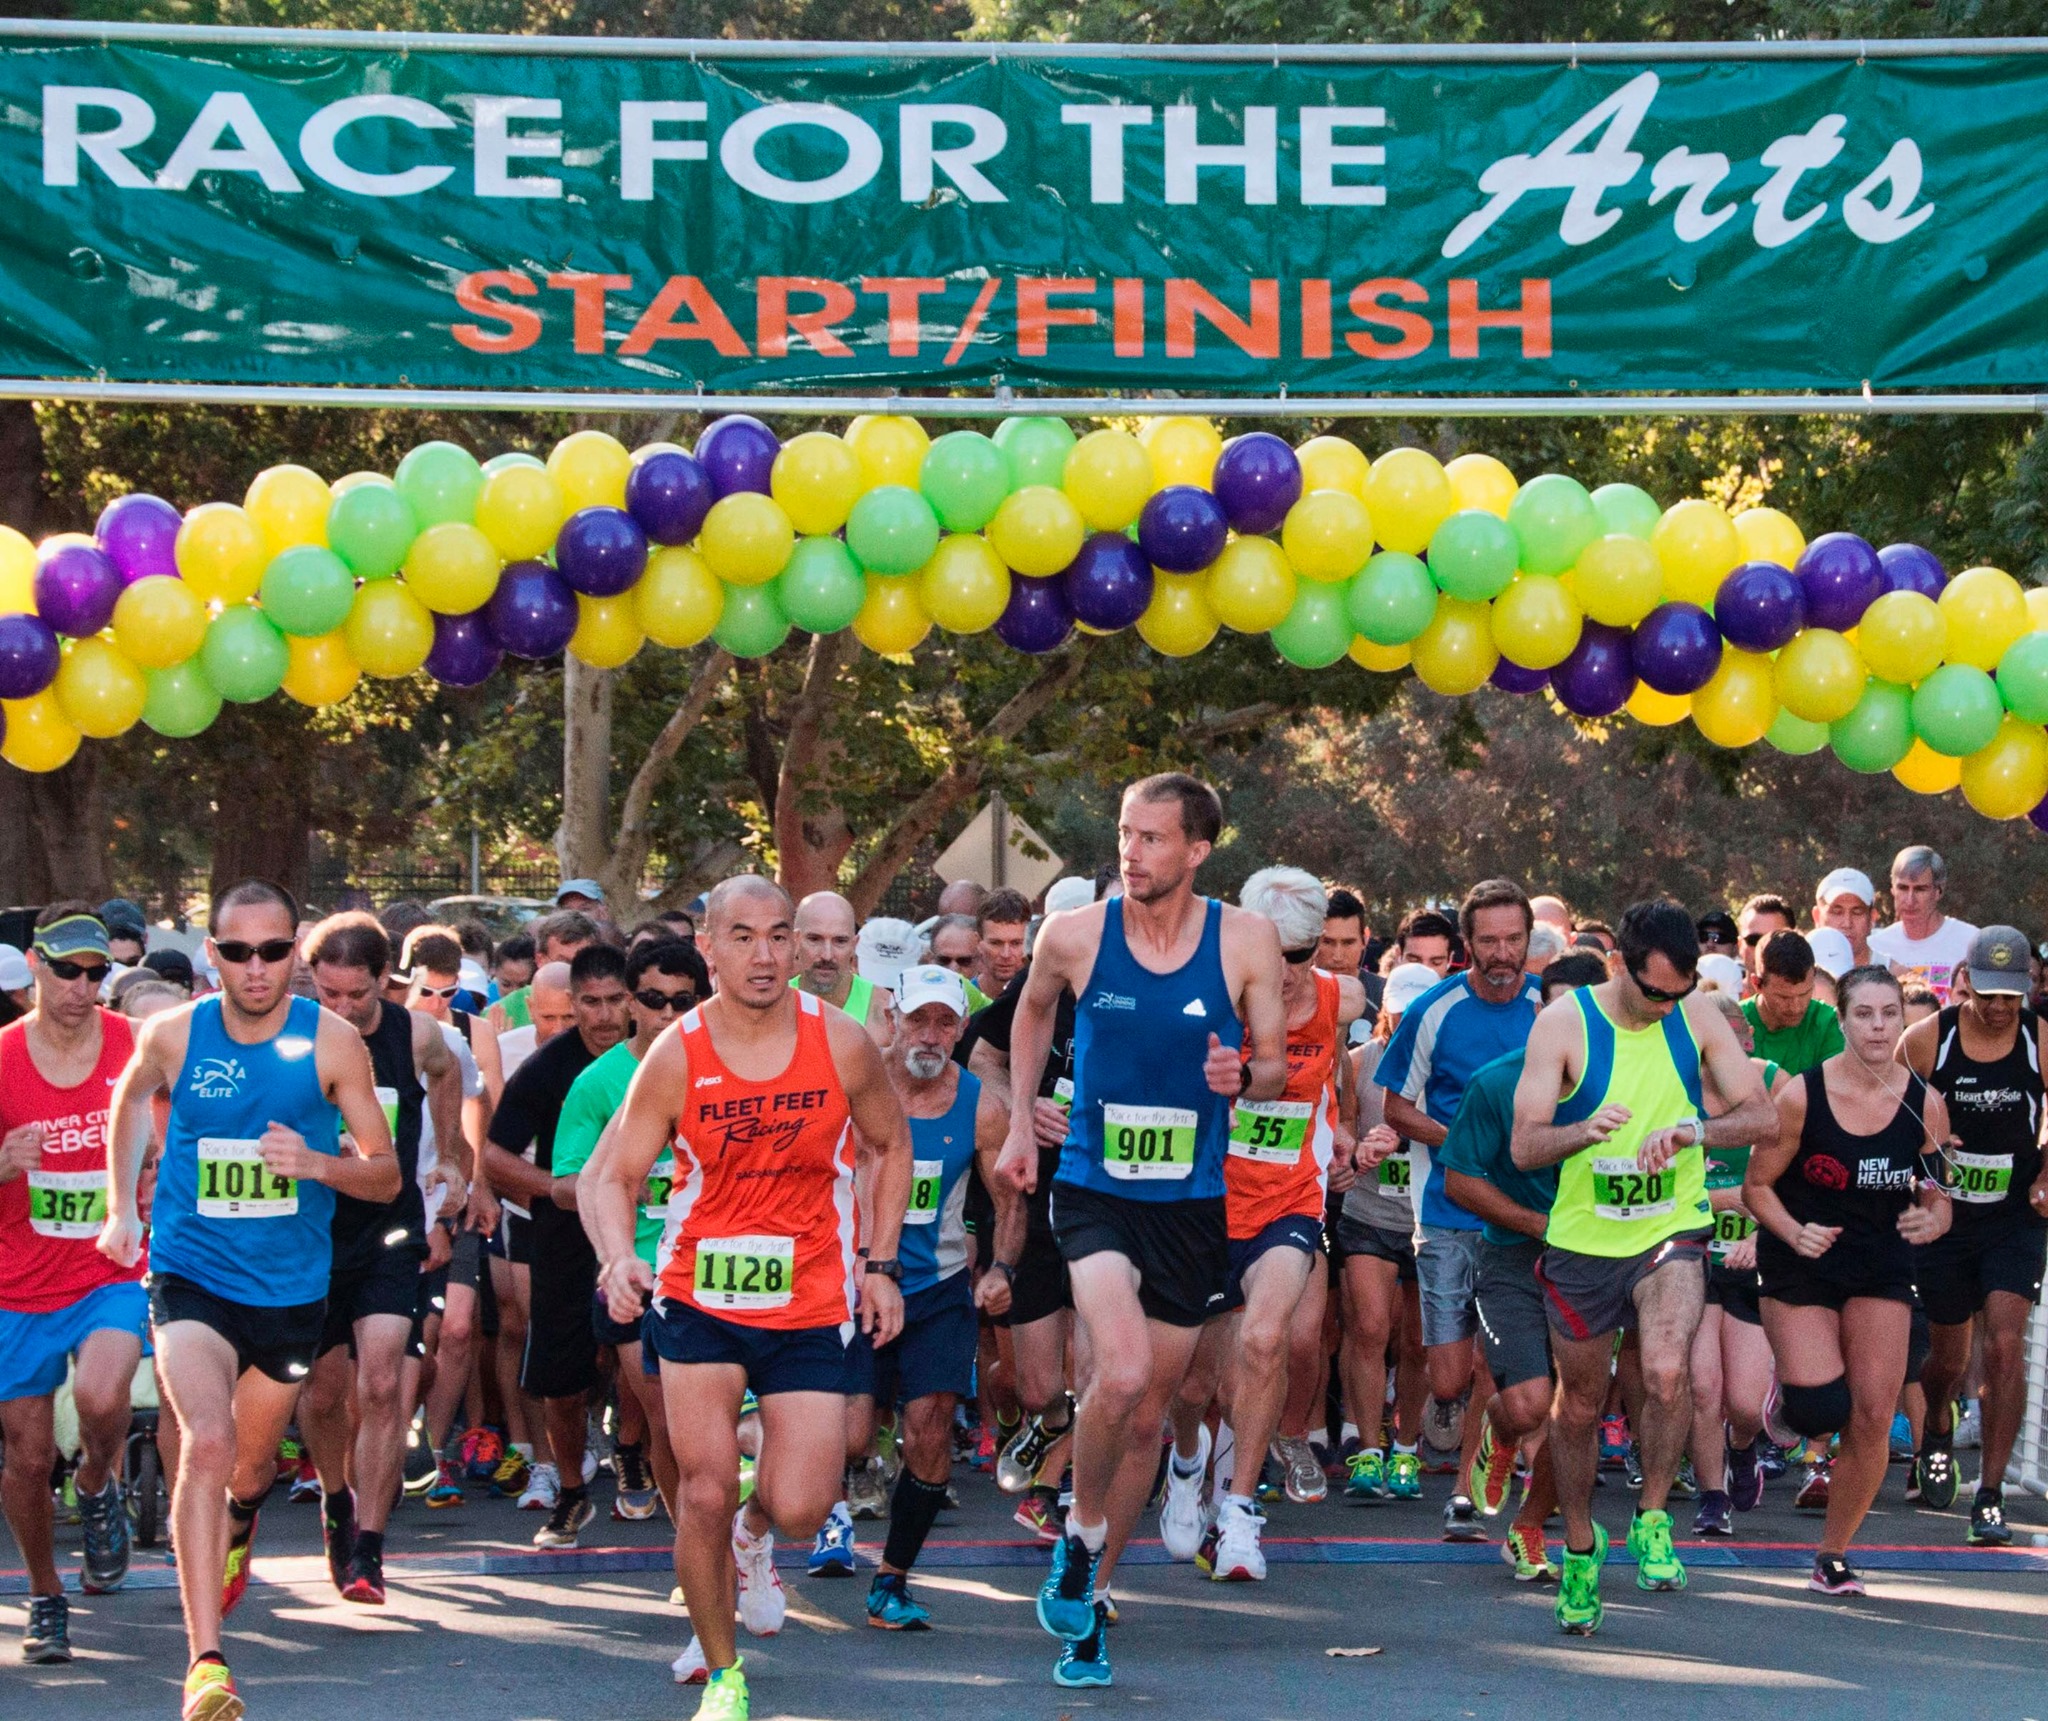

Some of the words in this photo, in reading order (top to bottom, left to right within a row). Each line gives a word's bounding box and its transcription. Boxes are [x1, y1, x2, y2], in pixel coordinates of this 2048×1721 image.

[42, 85, 563, 199] RACE
[620, 101, 1008, 203] FOR
[1061, 104, 1386, 206] THE
[1441, 71, 1935, 258] Arts
[451, 270, 1552, 365] START/FINISH
[199, 1087, 233, 1098] ELITE
[700, 1096, 766, 1122] FLEET
[773, 1089, 829, 1112] FEET
[1955, 1091, 1981, 1102] Heart
[2002, 1091, 2022, 1102] Sole
[86, 1109, 110, 1124] CIT
[1249, 1115, 1287, 1148] 55
[41, 1124, 109, 1154] EBEL
[707, 1117, 818, 1159] Racing
[1118, 1127, 1174, 1162] 901
[1858, 1157, 1889, 1171] NEW
[42, 1188, 96, 1222] 367
[912, 1179, 931, 1209] 8
[1608, 1174, 1662, 1206] 520
[702, 1252, 783, 1292] 1128
